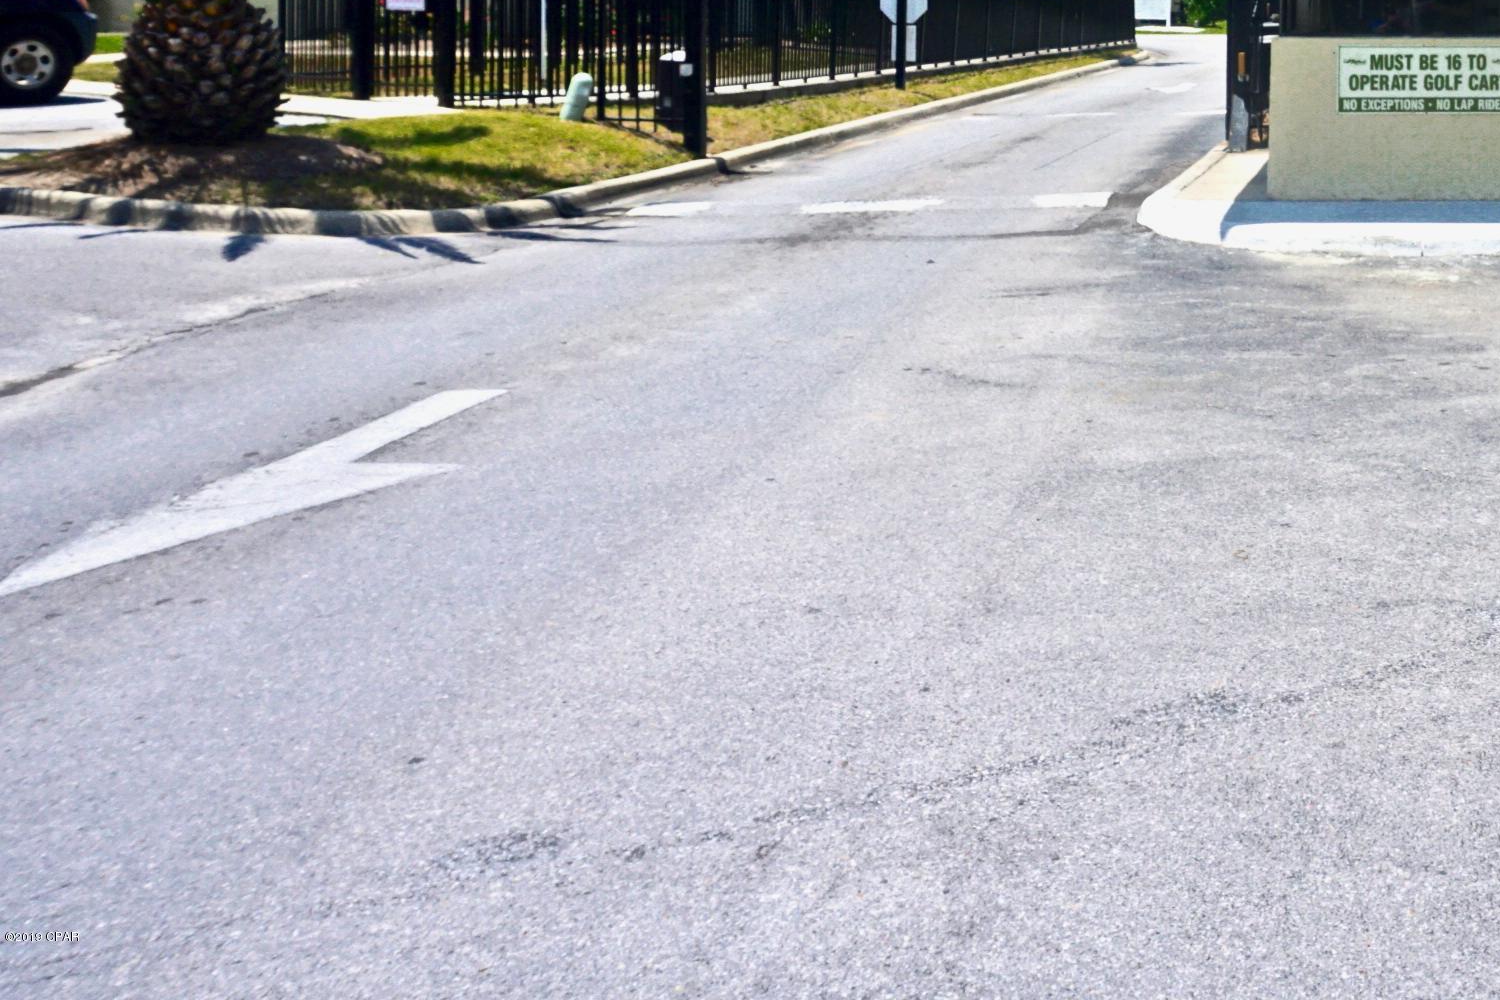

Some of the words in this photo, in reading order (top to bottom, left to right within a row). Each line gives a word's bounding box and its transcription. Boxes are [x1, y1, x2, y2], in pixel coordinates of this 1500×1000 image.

[1370, 54, 1413, 71] MUST
[1419, 54, 1438, 71] BE
[1445, 54, 1461, 71] 16
[1467, 54, 1487, 71] TO
[1348, 74, 1418, 91] OPERATE
[1423, 74, 1463, 91] GOLF
[1343, 99, 1357, 111] NO
[1361, 99, 1425, 111] EXCEPTIONS
[1436, 99, 1451, 111] NO
[1454, 99, 1474, 111] LAP
